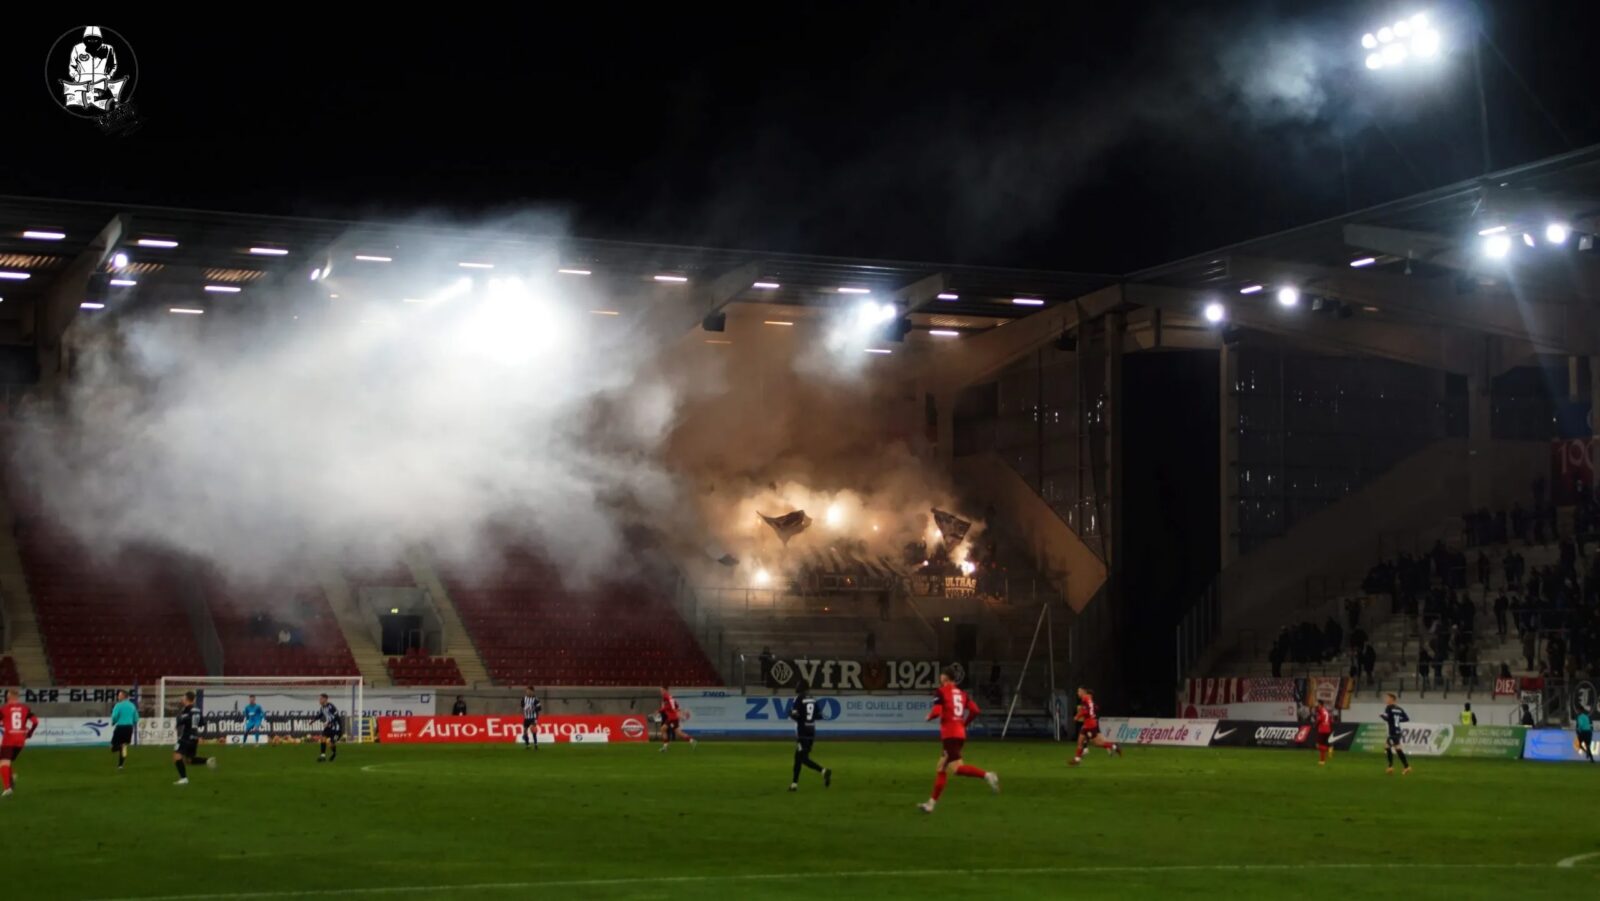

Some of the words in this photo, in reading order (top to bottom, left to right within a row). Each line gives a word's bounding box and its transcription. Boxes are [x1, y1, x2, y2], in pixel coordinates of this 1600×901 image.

[945, 577, 977, 587] ULTRAS
[793, 659, 864, 689] VfR
[886, 661, 942, 690] 1921
[1495, 679, 1516, 693] DIEZ
[26, 689, 59, 703] DER
[806, 703, 815, 721] 9
[846, 701, 863, 711] DIE
[865, 701, 903, 712] QUELLE
[906, 702, 927, 712] DER
[952, 694, 964, 717] 5
[11, 711, 22, 730] 6
[273, 719, 291, 732] und
[1116, 723, 1189, 744] flyergigant.de
